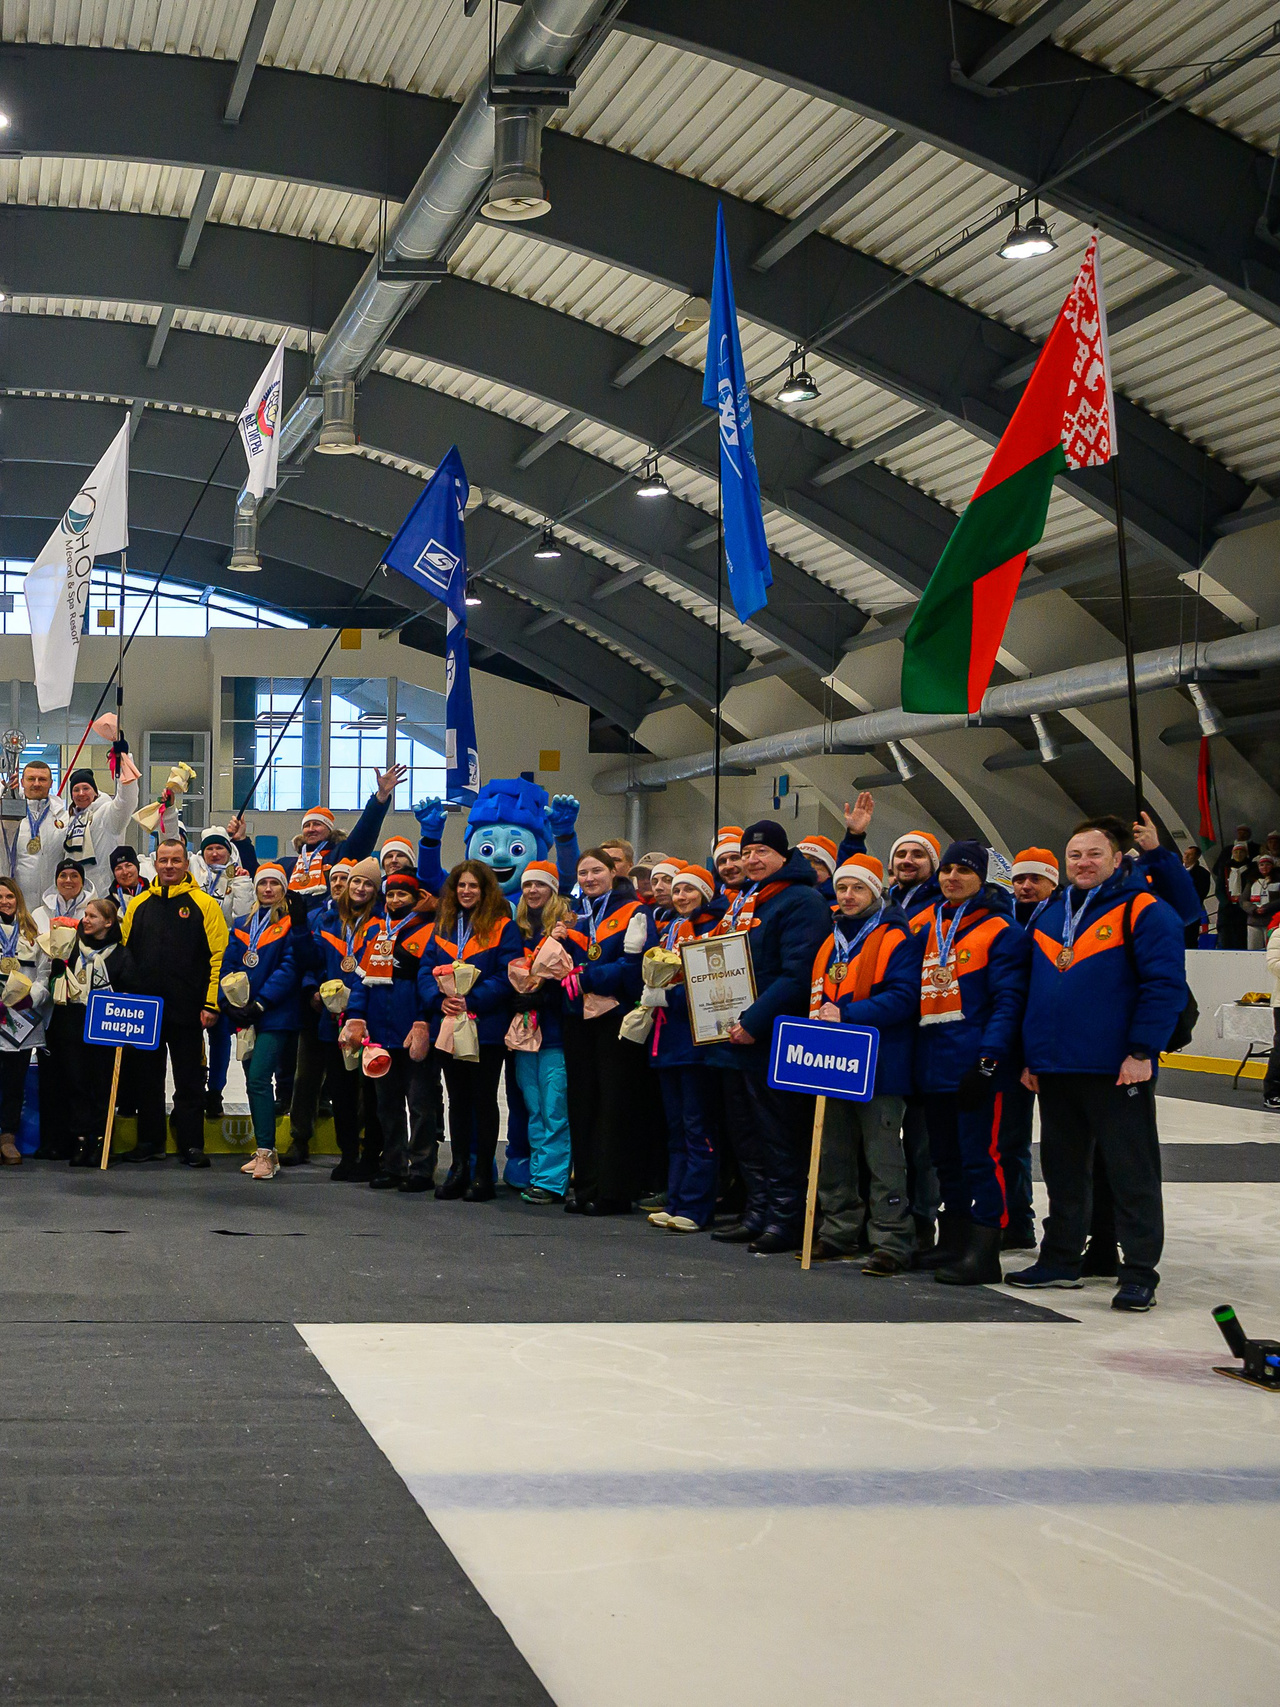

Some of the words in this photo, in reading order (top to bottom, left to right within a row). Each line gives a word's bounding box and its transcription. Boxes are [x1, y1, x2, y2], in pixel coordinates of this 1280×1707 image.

[65, 540, 75, 580] Medical
[67, 581, 76, 590] &
[67, 591, 76, 610] Spa
[70, 613, 80, 646] Resort
[691, 967, 746, 983] СЕРТИФИКАТ
[105, 1002, 145, 1019] Белые
[101, 1020, 145, 1037] тигры
[786, 1044, 860, 1073] Молния
